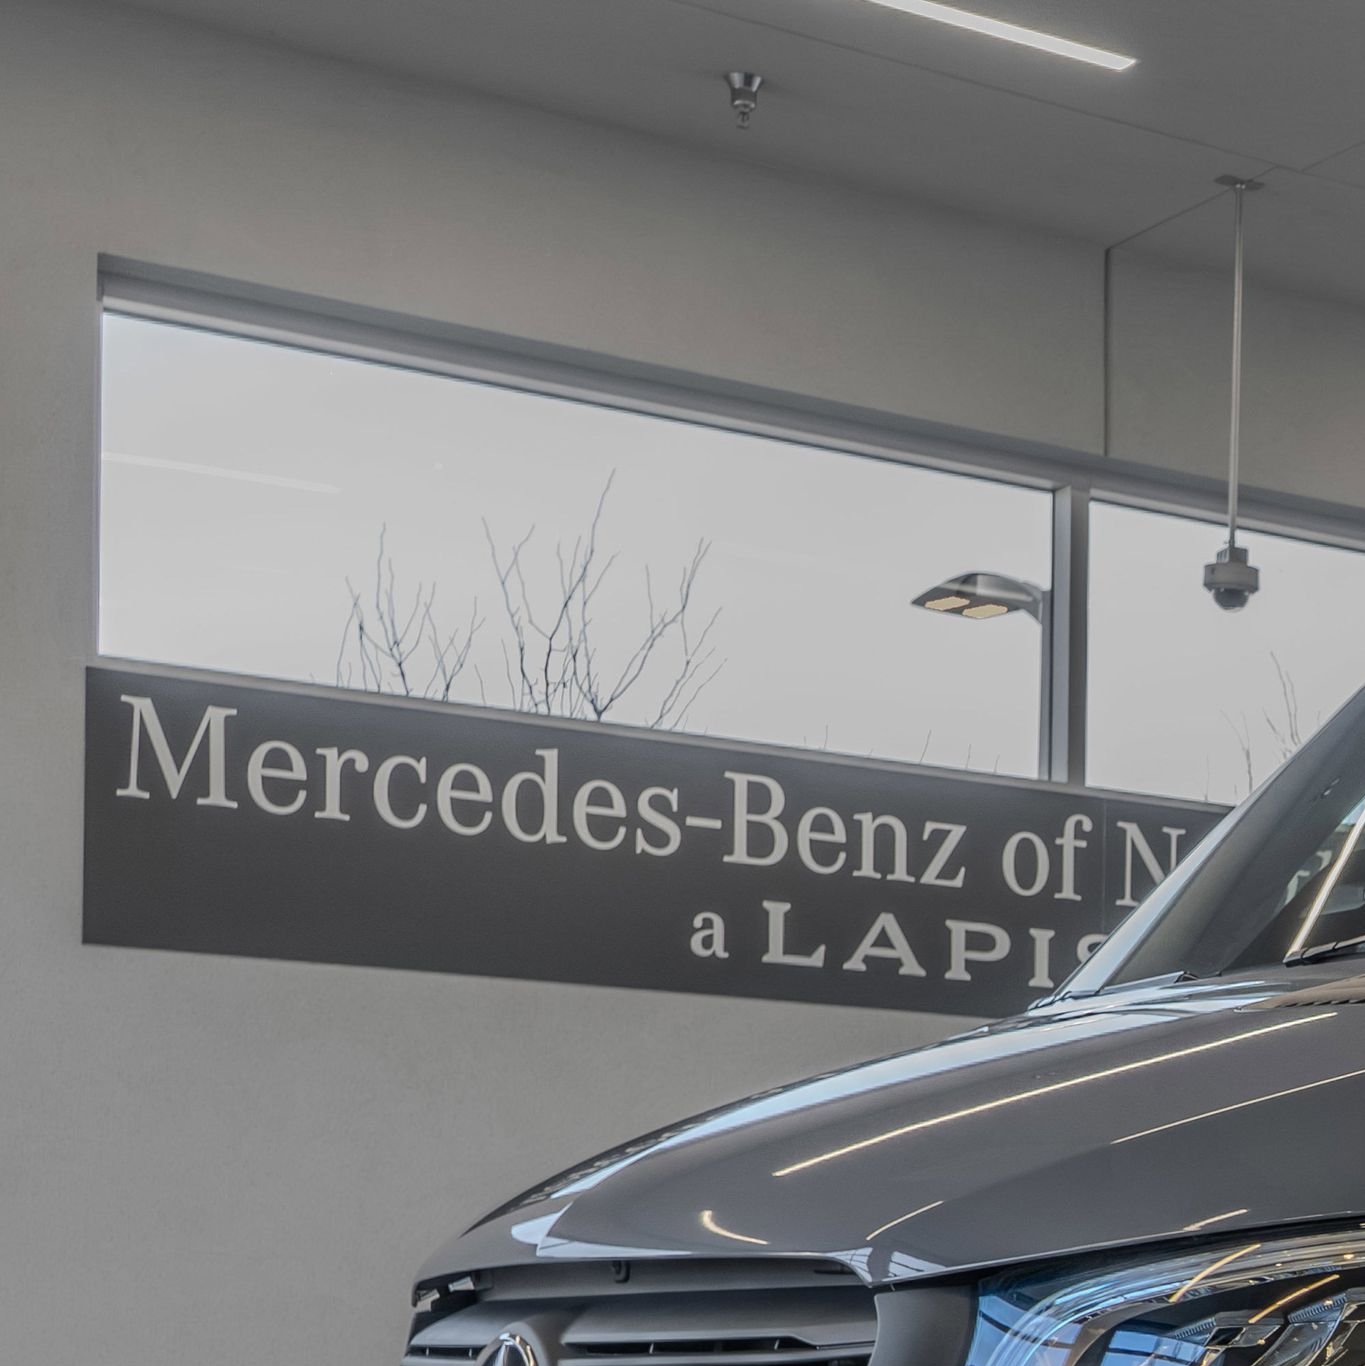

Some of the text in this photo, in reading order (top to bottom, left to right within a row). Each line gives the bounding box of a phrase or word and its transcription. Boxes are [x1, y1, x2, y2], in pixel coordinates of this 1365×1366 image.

[116, 695, 967, 888] Mercedes-Benz
[1002, 813, 1093, 901] of
[690, 910, 729, 959] a
